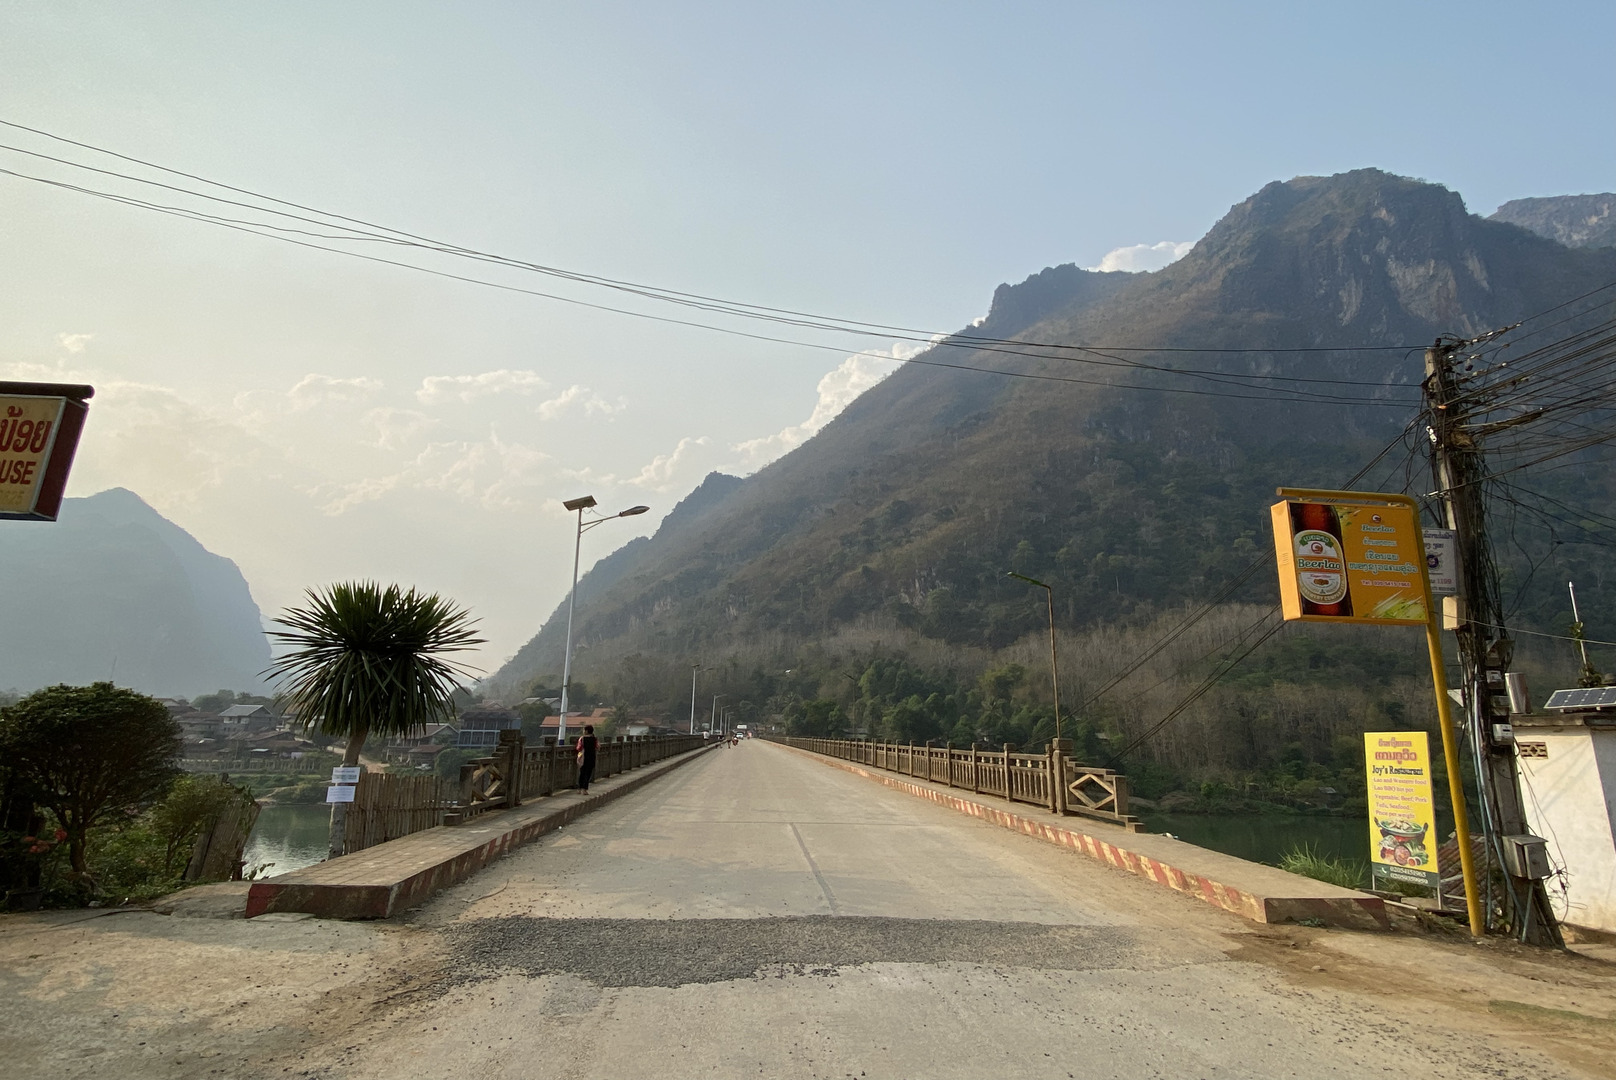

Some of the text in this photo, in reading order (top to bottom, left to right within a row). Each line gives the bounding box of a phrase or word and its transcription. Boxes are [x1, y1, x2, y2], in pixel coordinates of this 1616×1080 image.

[1361, 524, 1395, 533] Beerlao
[1298, 558, 1341, 570] Beerlao
[1372, 765, 1423, 775] Joy's Restaurant
